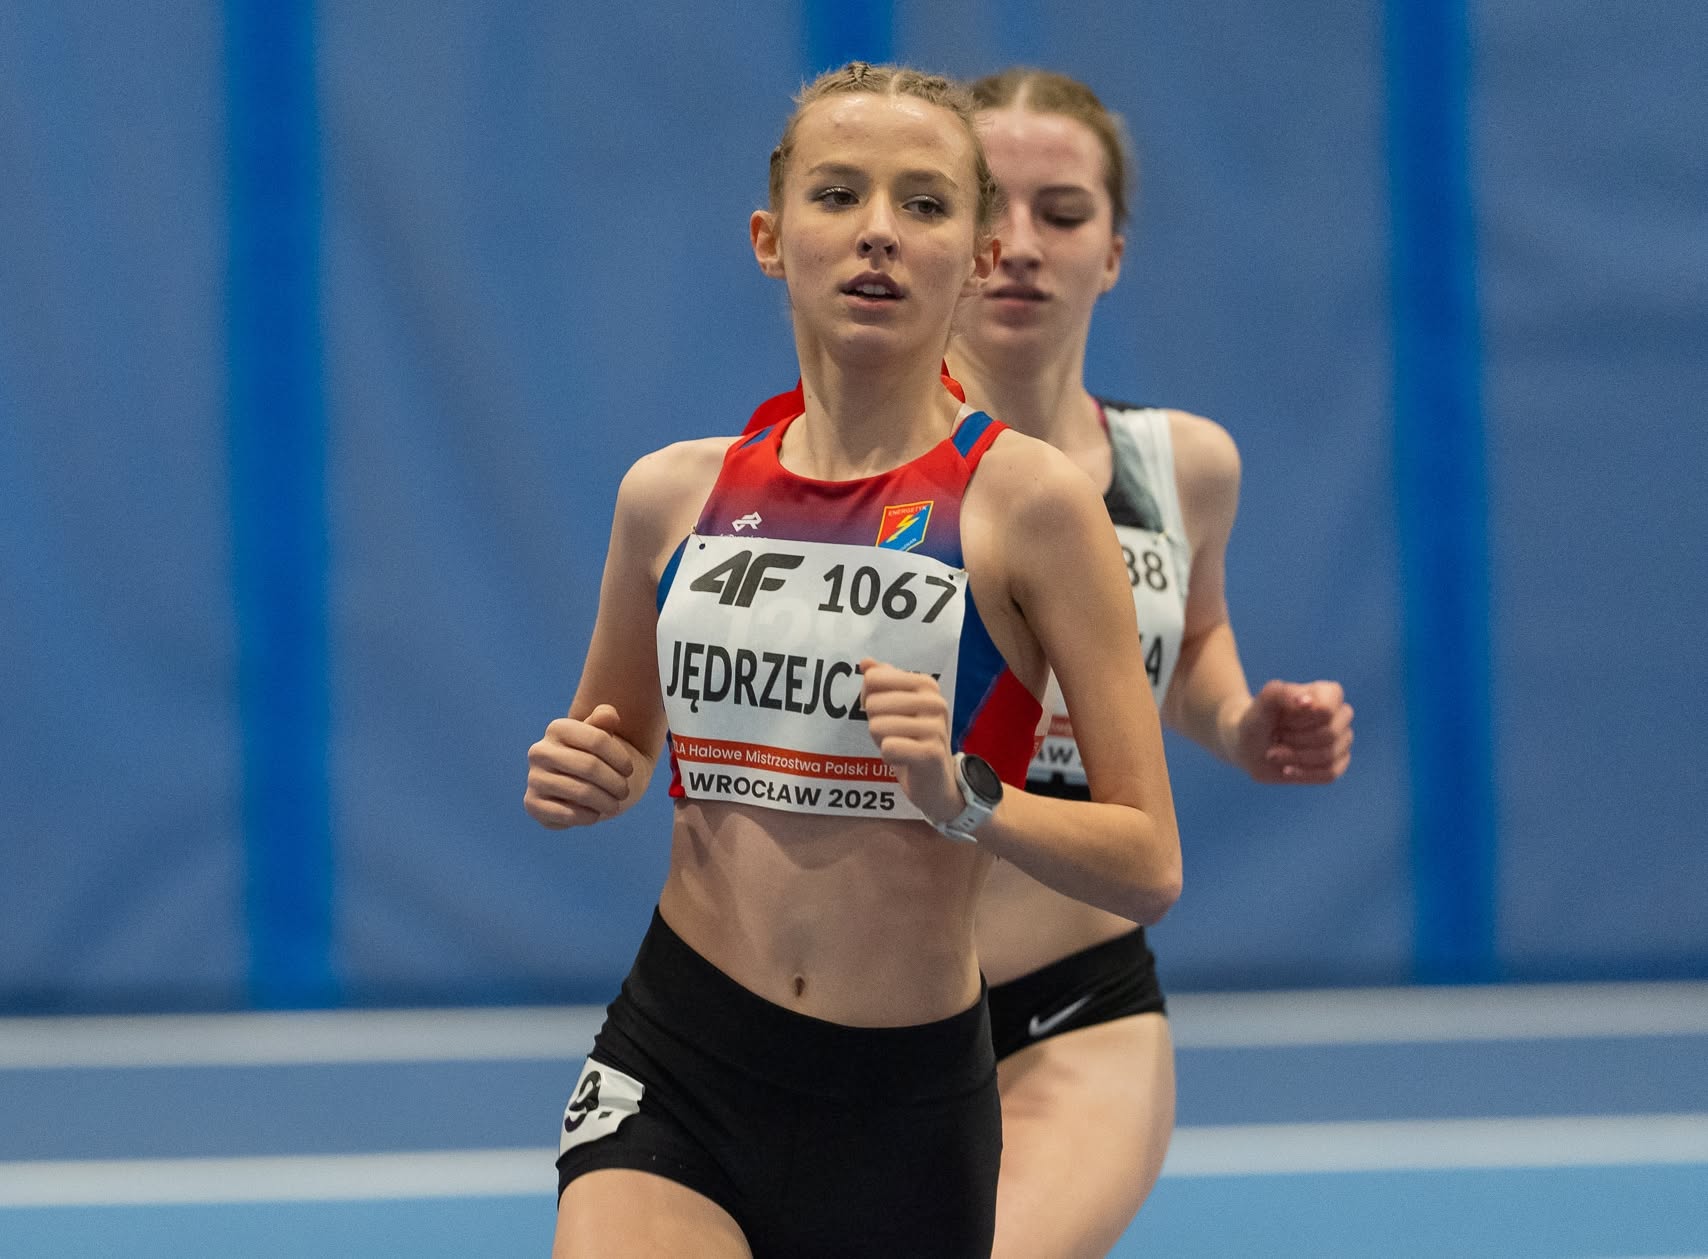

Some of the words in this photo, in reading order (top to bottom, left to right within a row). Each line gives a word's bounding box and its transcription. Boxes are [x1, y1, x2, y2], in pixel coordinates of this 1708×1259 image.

[689, 550, 805, 608] 4F
[818, 564, 957, 623] 1067
[666, 640, 941, 721] JĘDRZEJCZ
[689, 743, 742, 760] Halowe
[745, 750, 820, 773] Mistrzostwa
[825, 761, 868, 776] Polski
[688, 771, 822, 806] WROCŁAW
[828, 788, 895, 811] 2025
